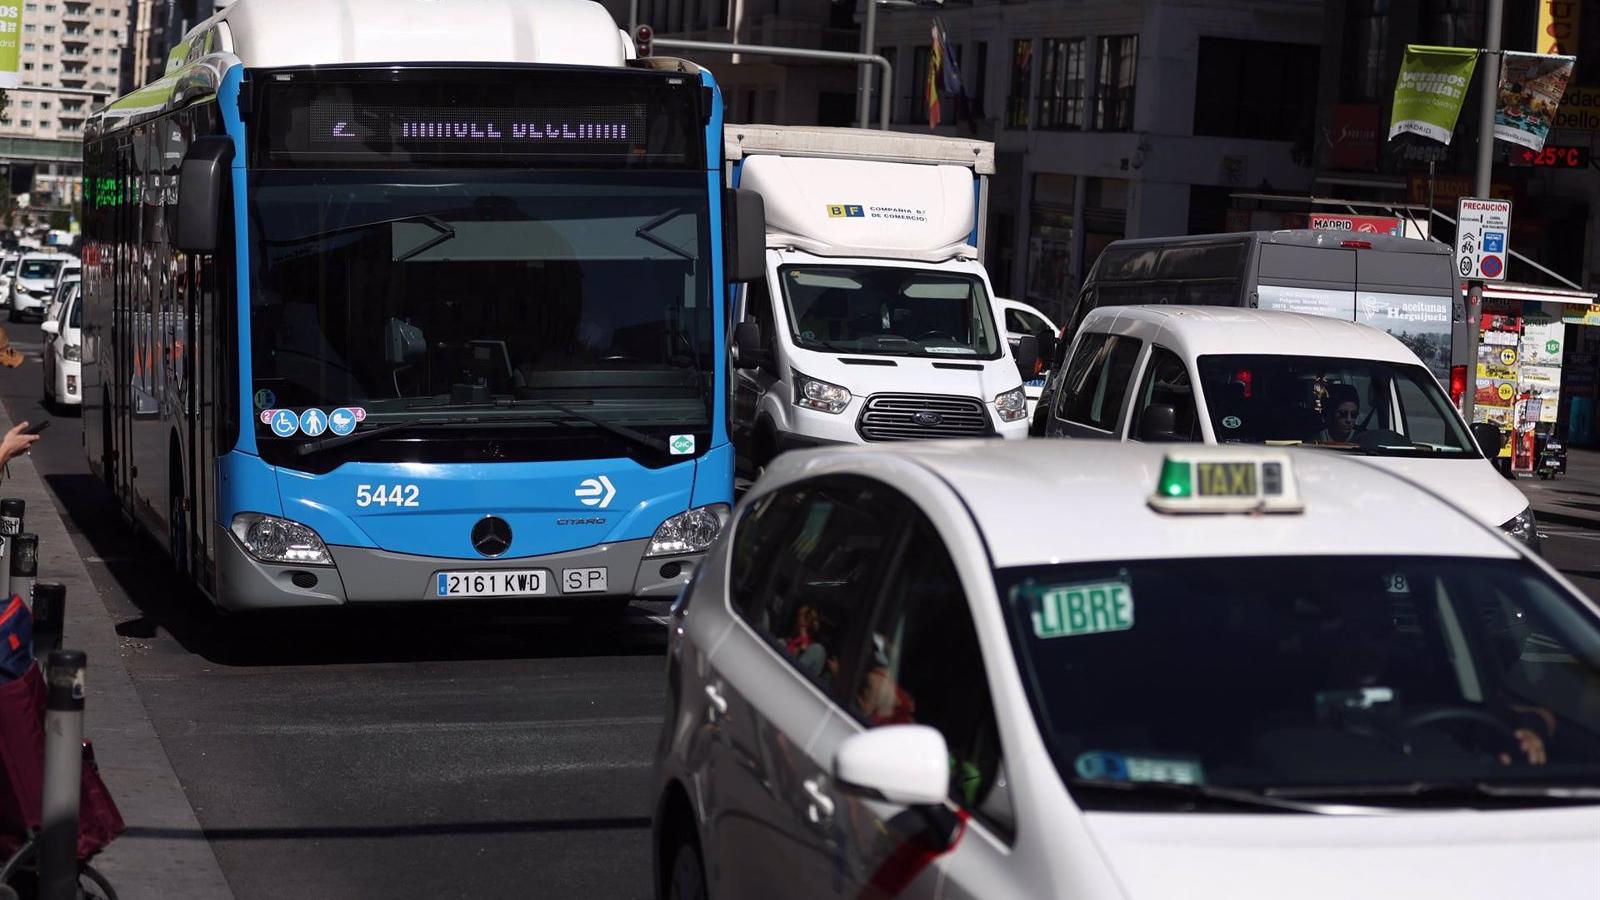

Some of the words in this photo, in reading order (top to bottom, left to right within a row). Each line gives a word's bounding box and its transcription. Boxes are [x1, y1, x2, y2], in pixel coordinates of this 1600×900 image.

[831, 206, 842, 215] B
[850, 207, 859, 215] F
[1313, 219, 1352, 231] MADRID
[1402, 301, 1447, 314] aceitunas
[264, 411, 270, 420] 2
[356, 409, 362, 419] 4
[674, 441, 691, 449] GNC
[1198, 462, 1256, 495] TAXI
[356, 484, 420, 507] 5442
[449, 576, 496, 593] 2161
[505, 574, 540, 592] KWD
[1040, 587, 1128, 632] LIBRE
